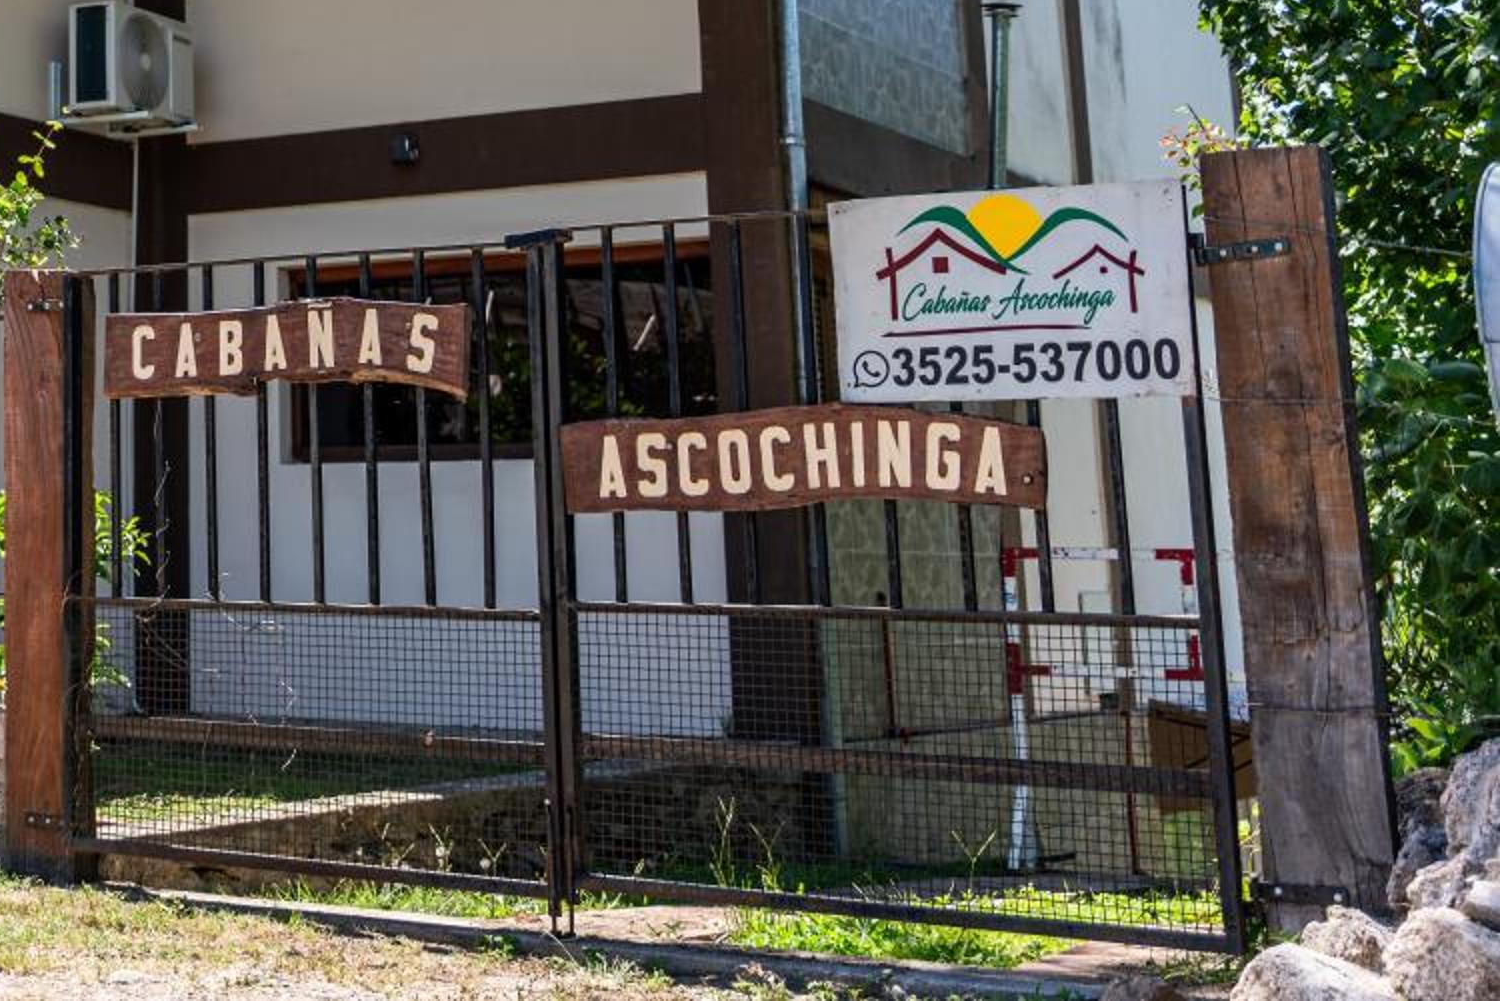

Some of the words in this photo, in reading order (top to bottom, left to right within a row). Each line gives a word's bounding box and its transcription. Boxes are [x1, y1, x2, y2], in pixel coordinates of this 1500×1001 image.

[902, 282, 991, 322] Cabañas
[991, 278, 1117, 325] Ascochinga
[131, 302, 439, 381] CABAÑAS
[892, 337, 1181, 387] 3525-537000
[599, 419, 1008, 499] ASCOCHINGA
